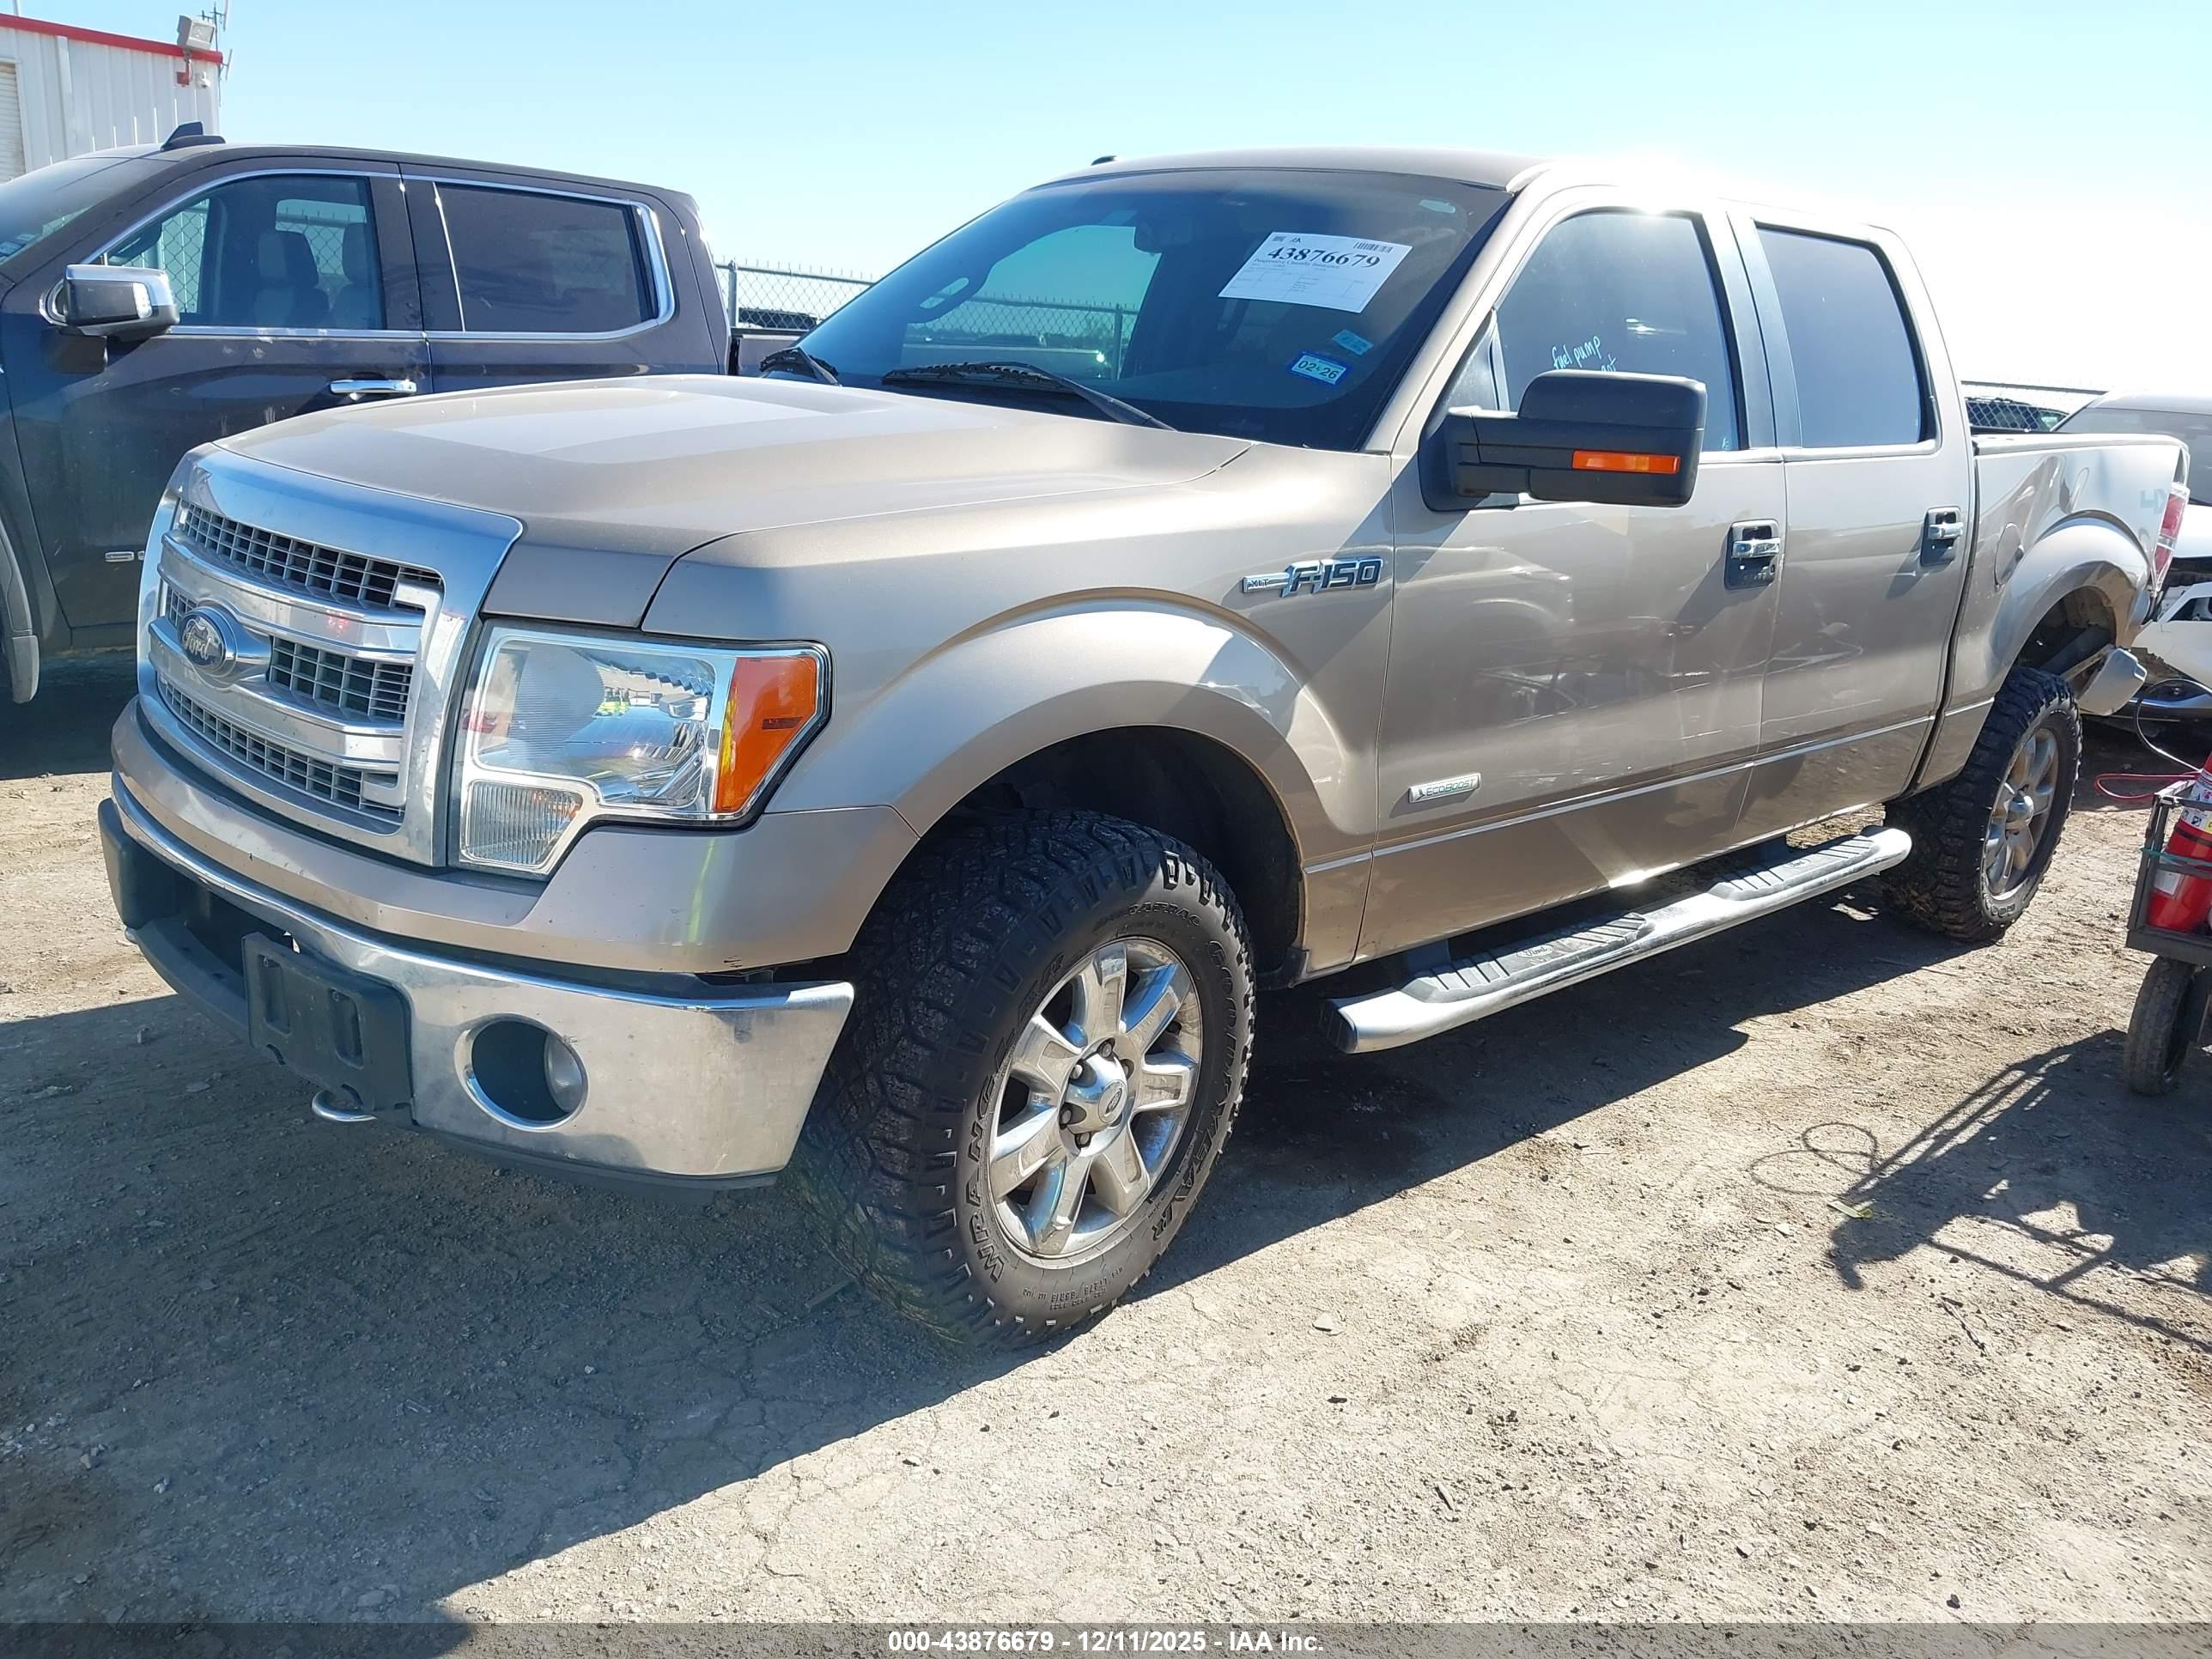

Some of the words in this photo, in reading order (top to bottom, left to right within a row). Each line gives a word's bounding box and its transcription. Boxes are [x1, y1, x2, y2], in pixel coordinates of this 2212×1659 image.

[1267, 246, 1381, 268] 43876679
[1573, 336, 1602, 368] pump
[1251, 578, 1269, 587] XLT
[184, 619, 212, 659] Ford
[1426, 779, 1475, 796] ECOBOOST
